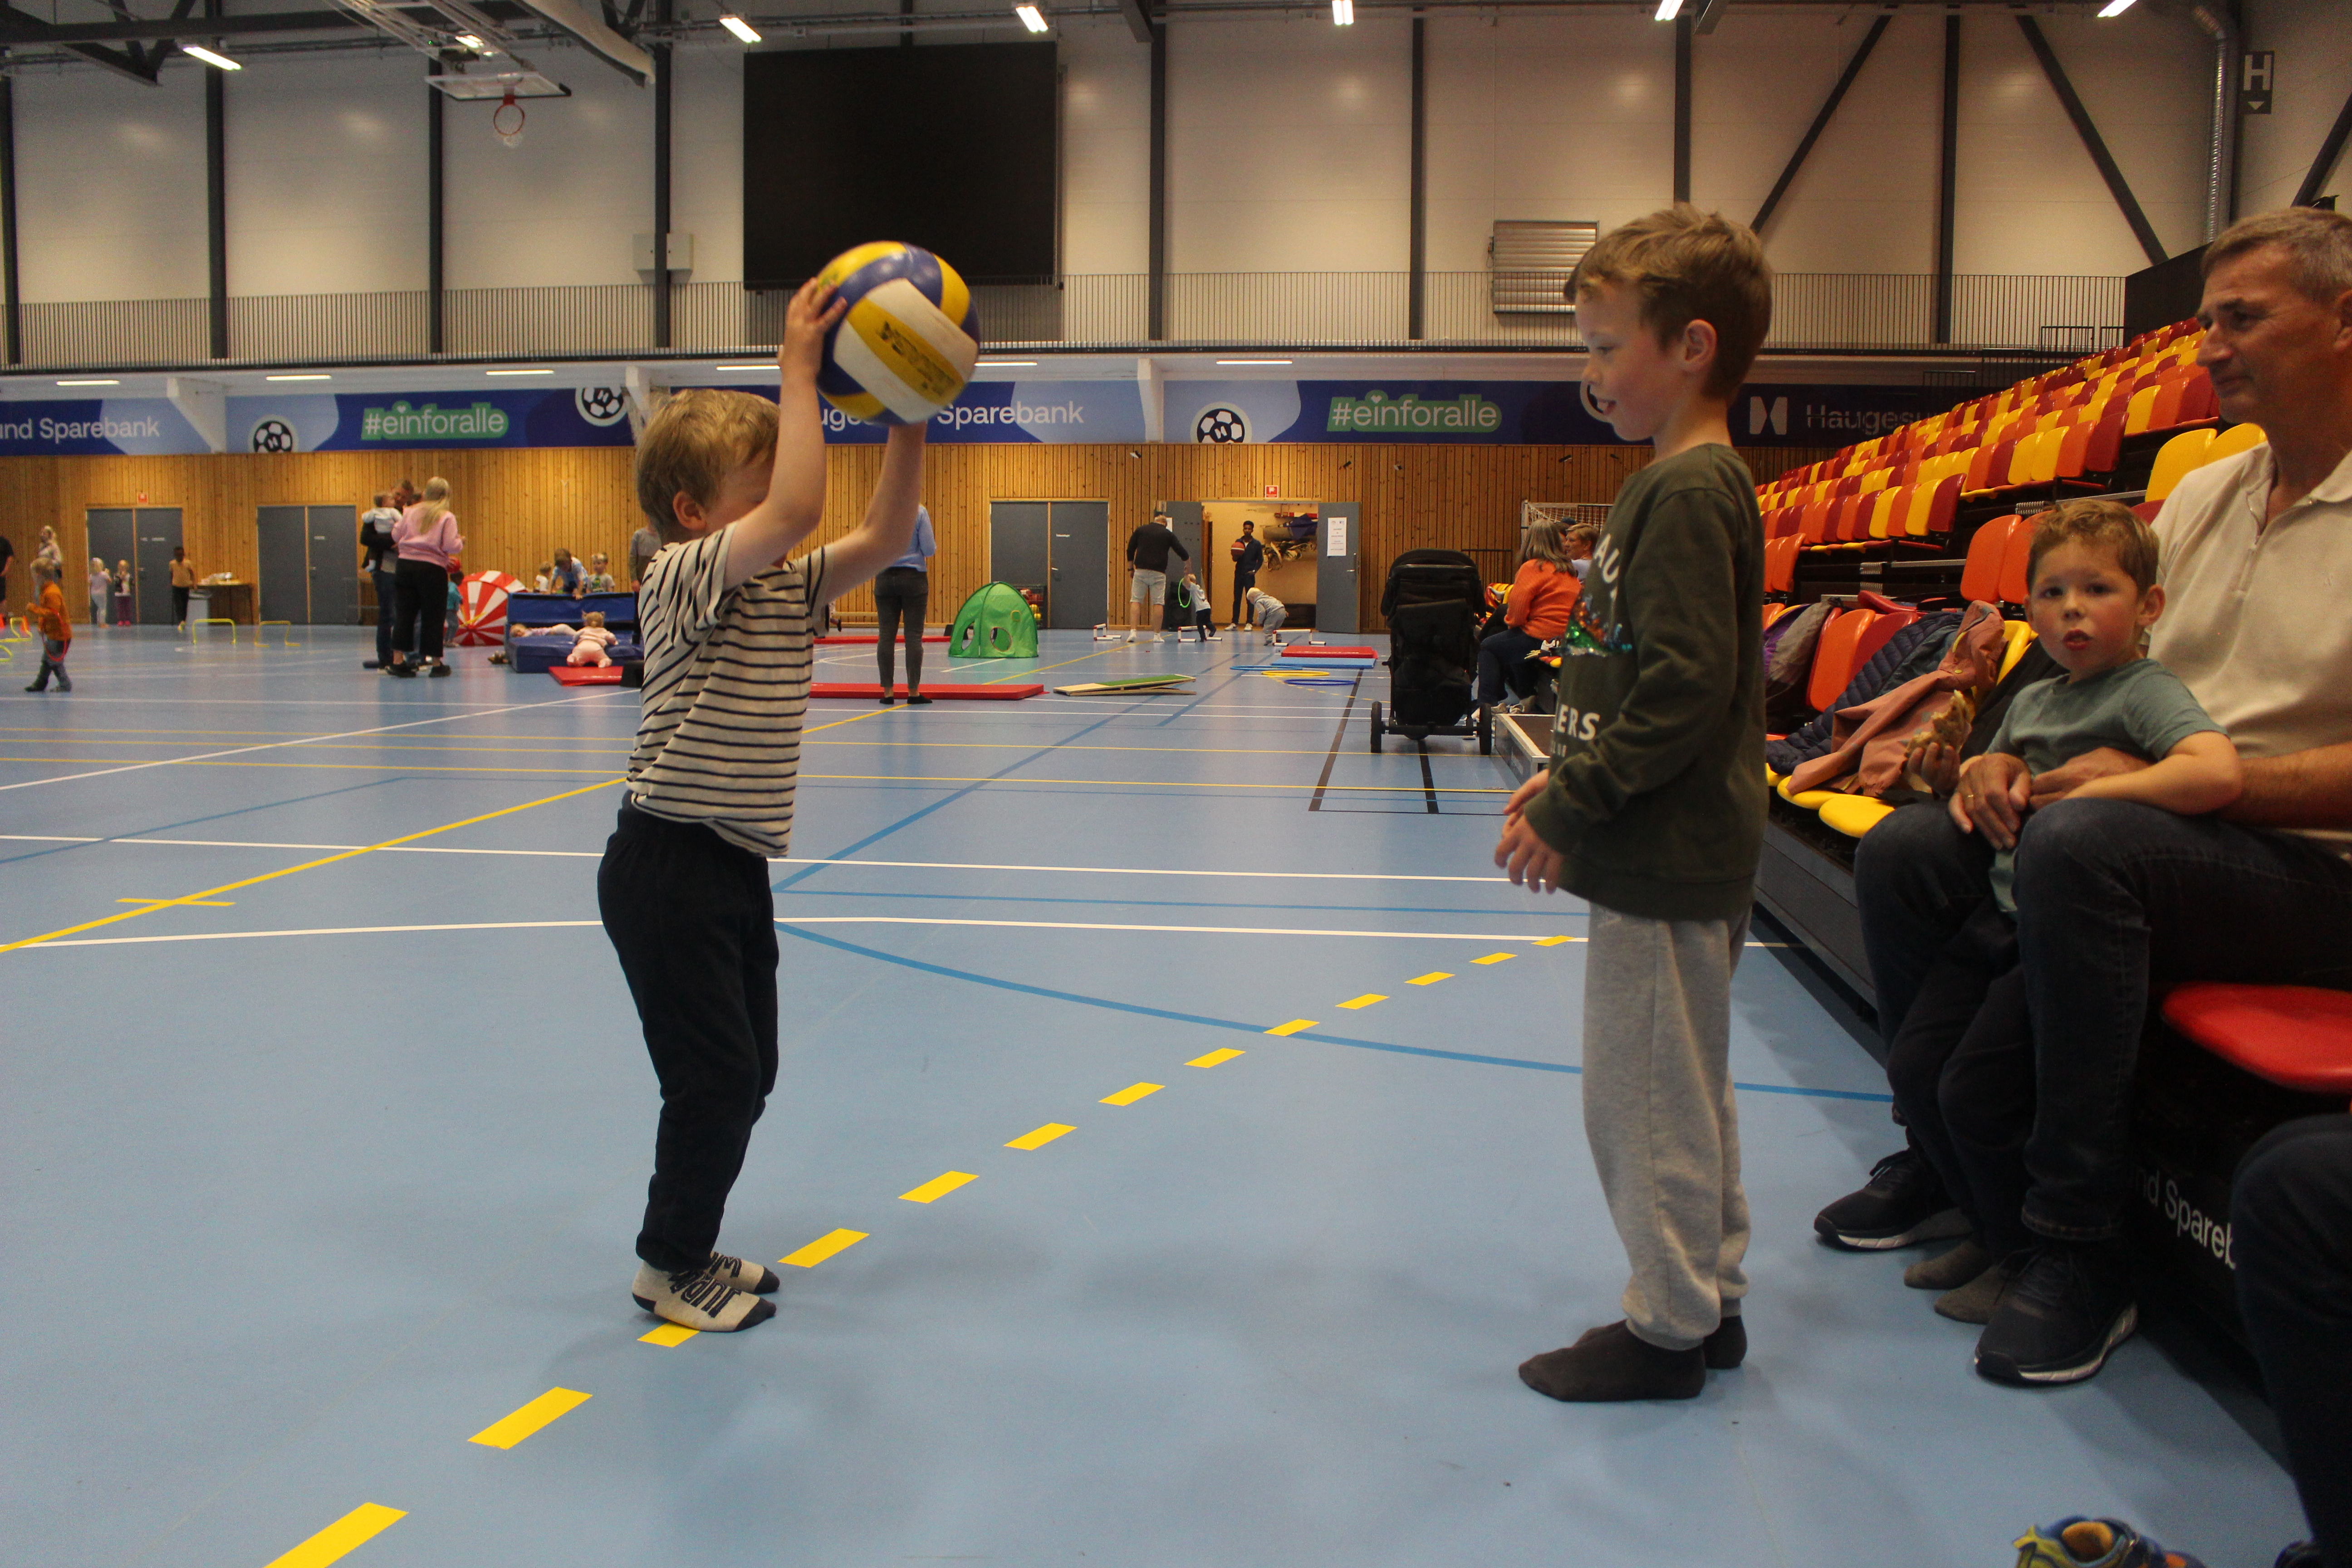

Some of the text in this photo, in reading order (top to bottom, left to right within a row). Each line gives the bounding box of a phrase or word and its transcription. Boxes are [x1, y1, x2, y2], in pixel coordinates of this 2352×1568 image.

[2243, 54, 2272, 90] H
[365, 405, 504, 435] #einforalle
[1333, 394, 1497, 427] #einforalle
[39, 415, 160, 444] Sparebank
